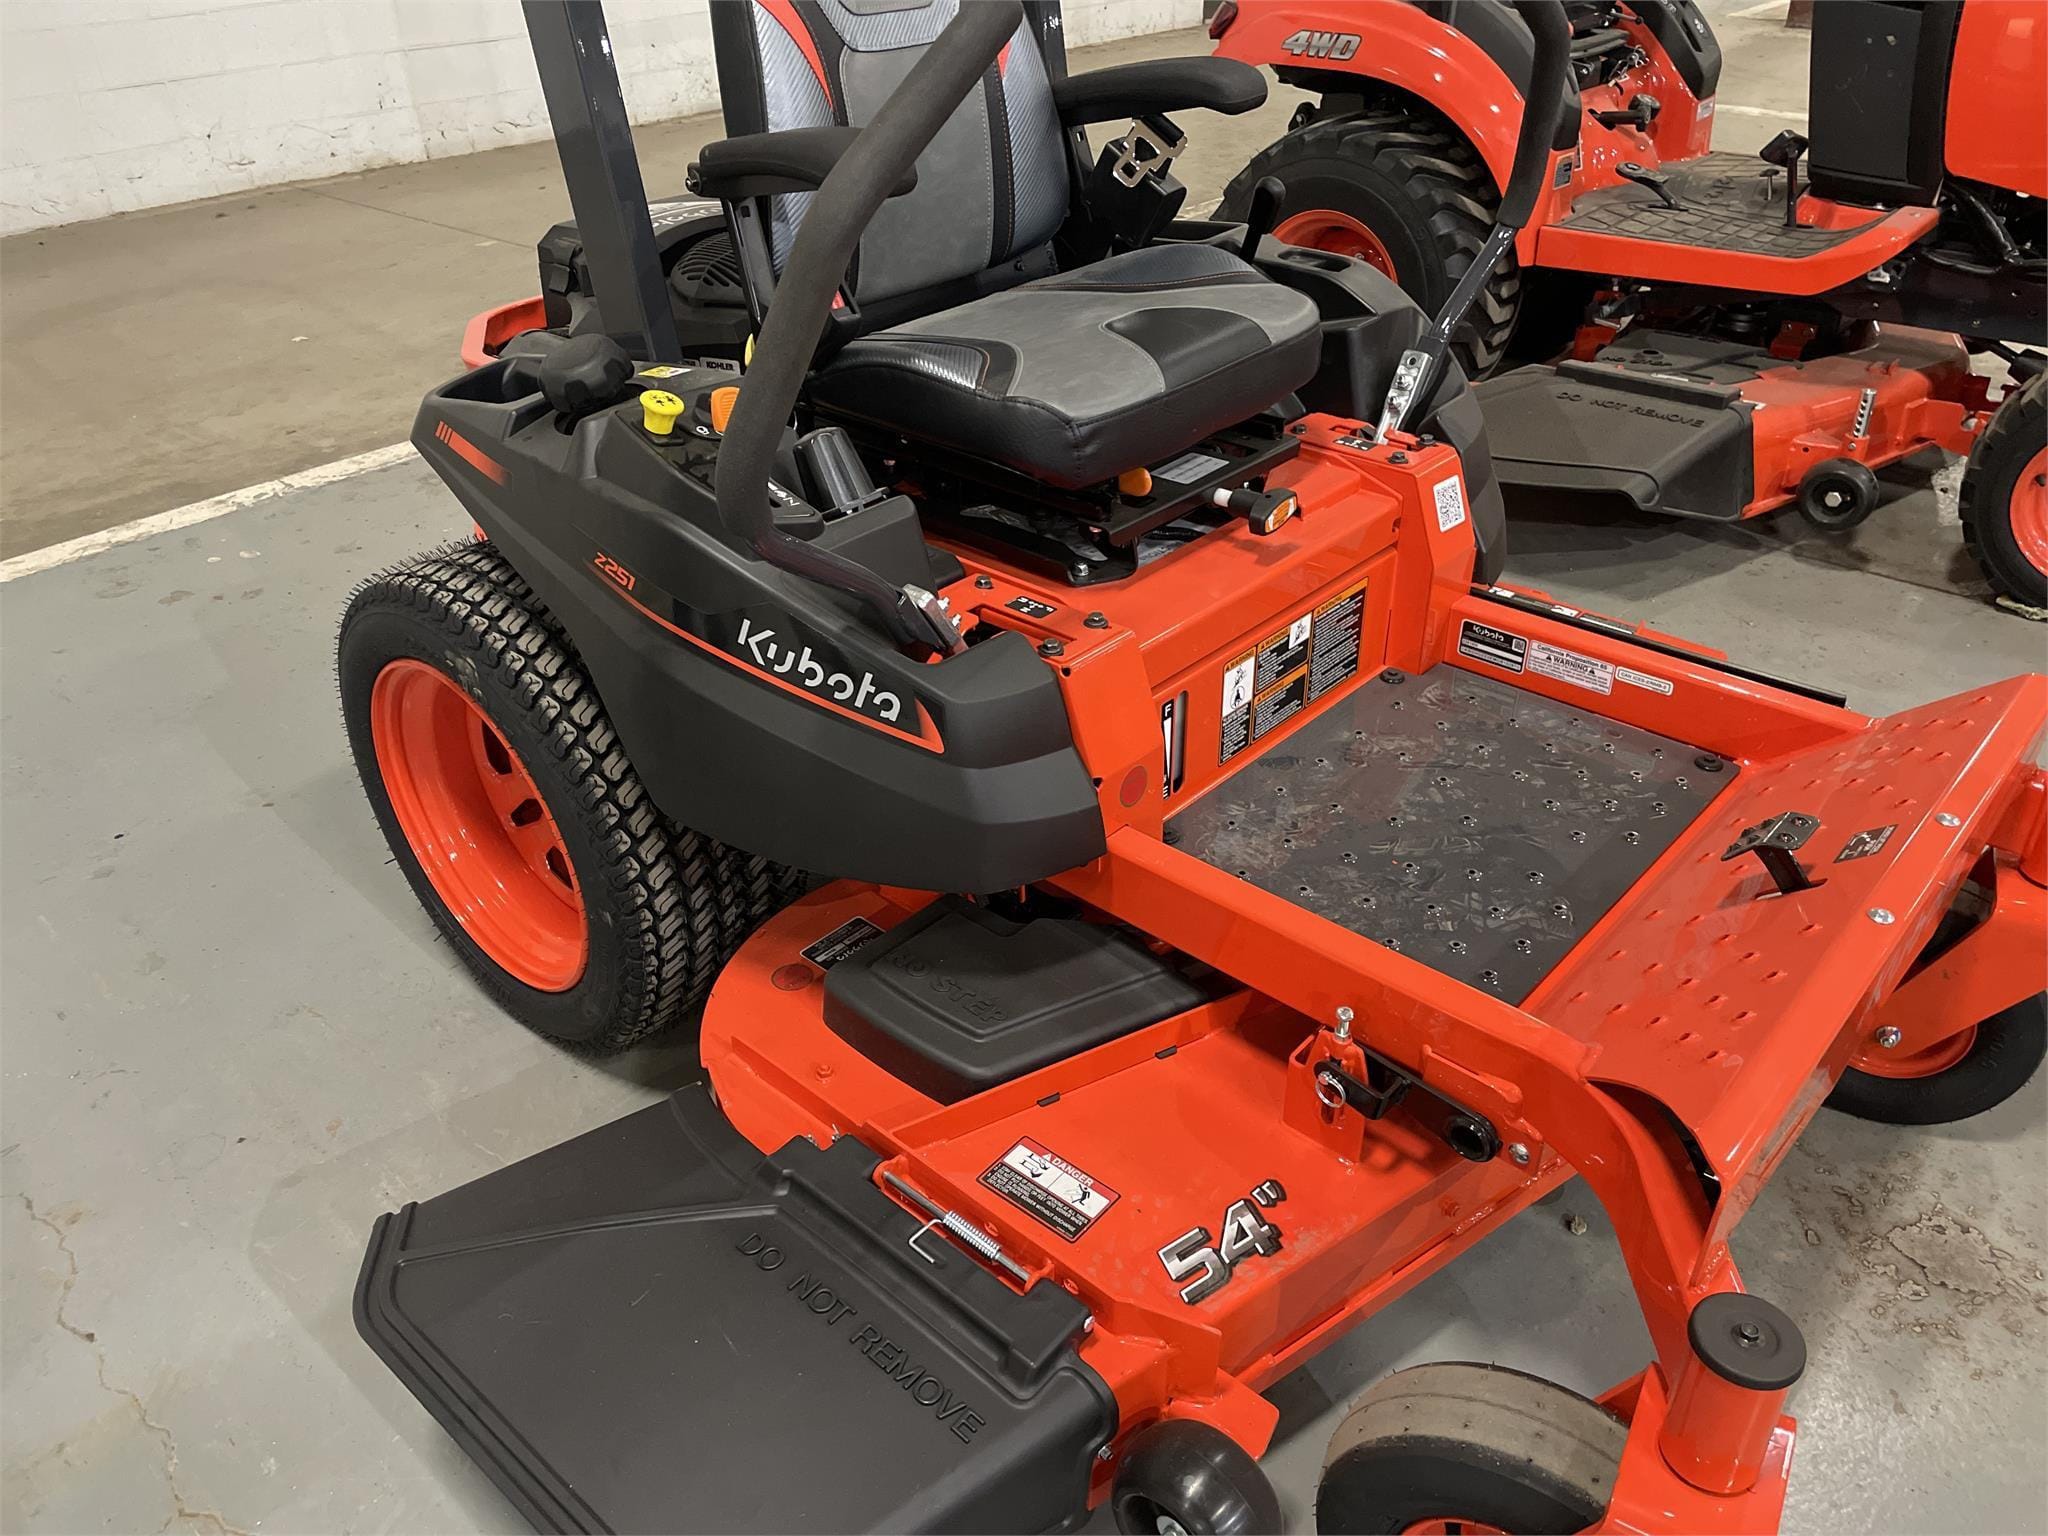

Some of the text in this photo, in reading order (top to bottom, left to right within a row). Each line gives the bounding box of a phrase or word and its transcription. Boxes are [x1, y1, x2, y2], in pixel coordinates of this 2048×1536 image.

[1281, 29, 1362, 60] 4WD
[706, 361, 735, 371] KOHLER
[1556, 392, 1705, 428] DO NOT REMOVE
[594, 551, 636, 591] Z251
[1473, 625, 1504, 642] Kubota
[737, 618, 901, 722] Kubota
[1552, 656, 1588, 672] WARNING
[1165, 703, 1172, 717] F
[894, 955, 1008, 1022] NO STEP
[1050, 1157, 1095, 1186] DANGER
[1157, 1179, 1286, 1305] 54"
[736, 1232, 986, 1444] DO NOT REMOVE
